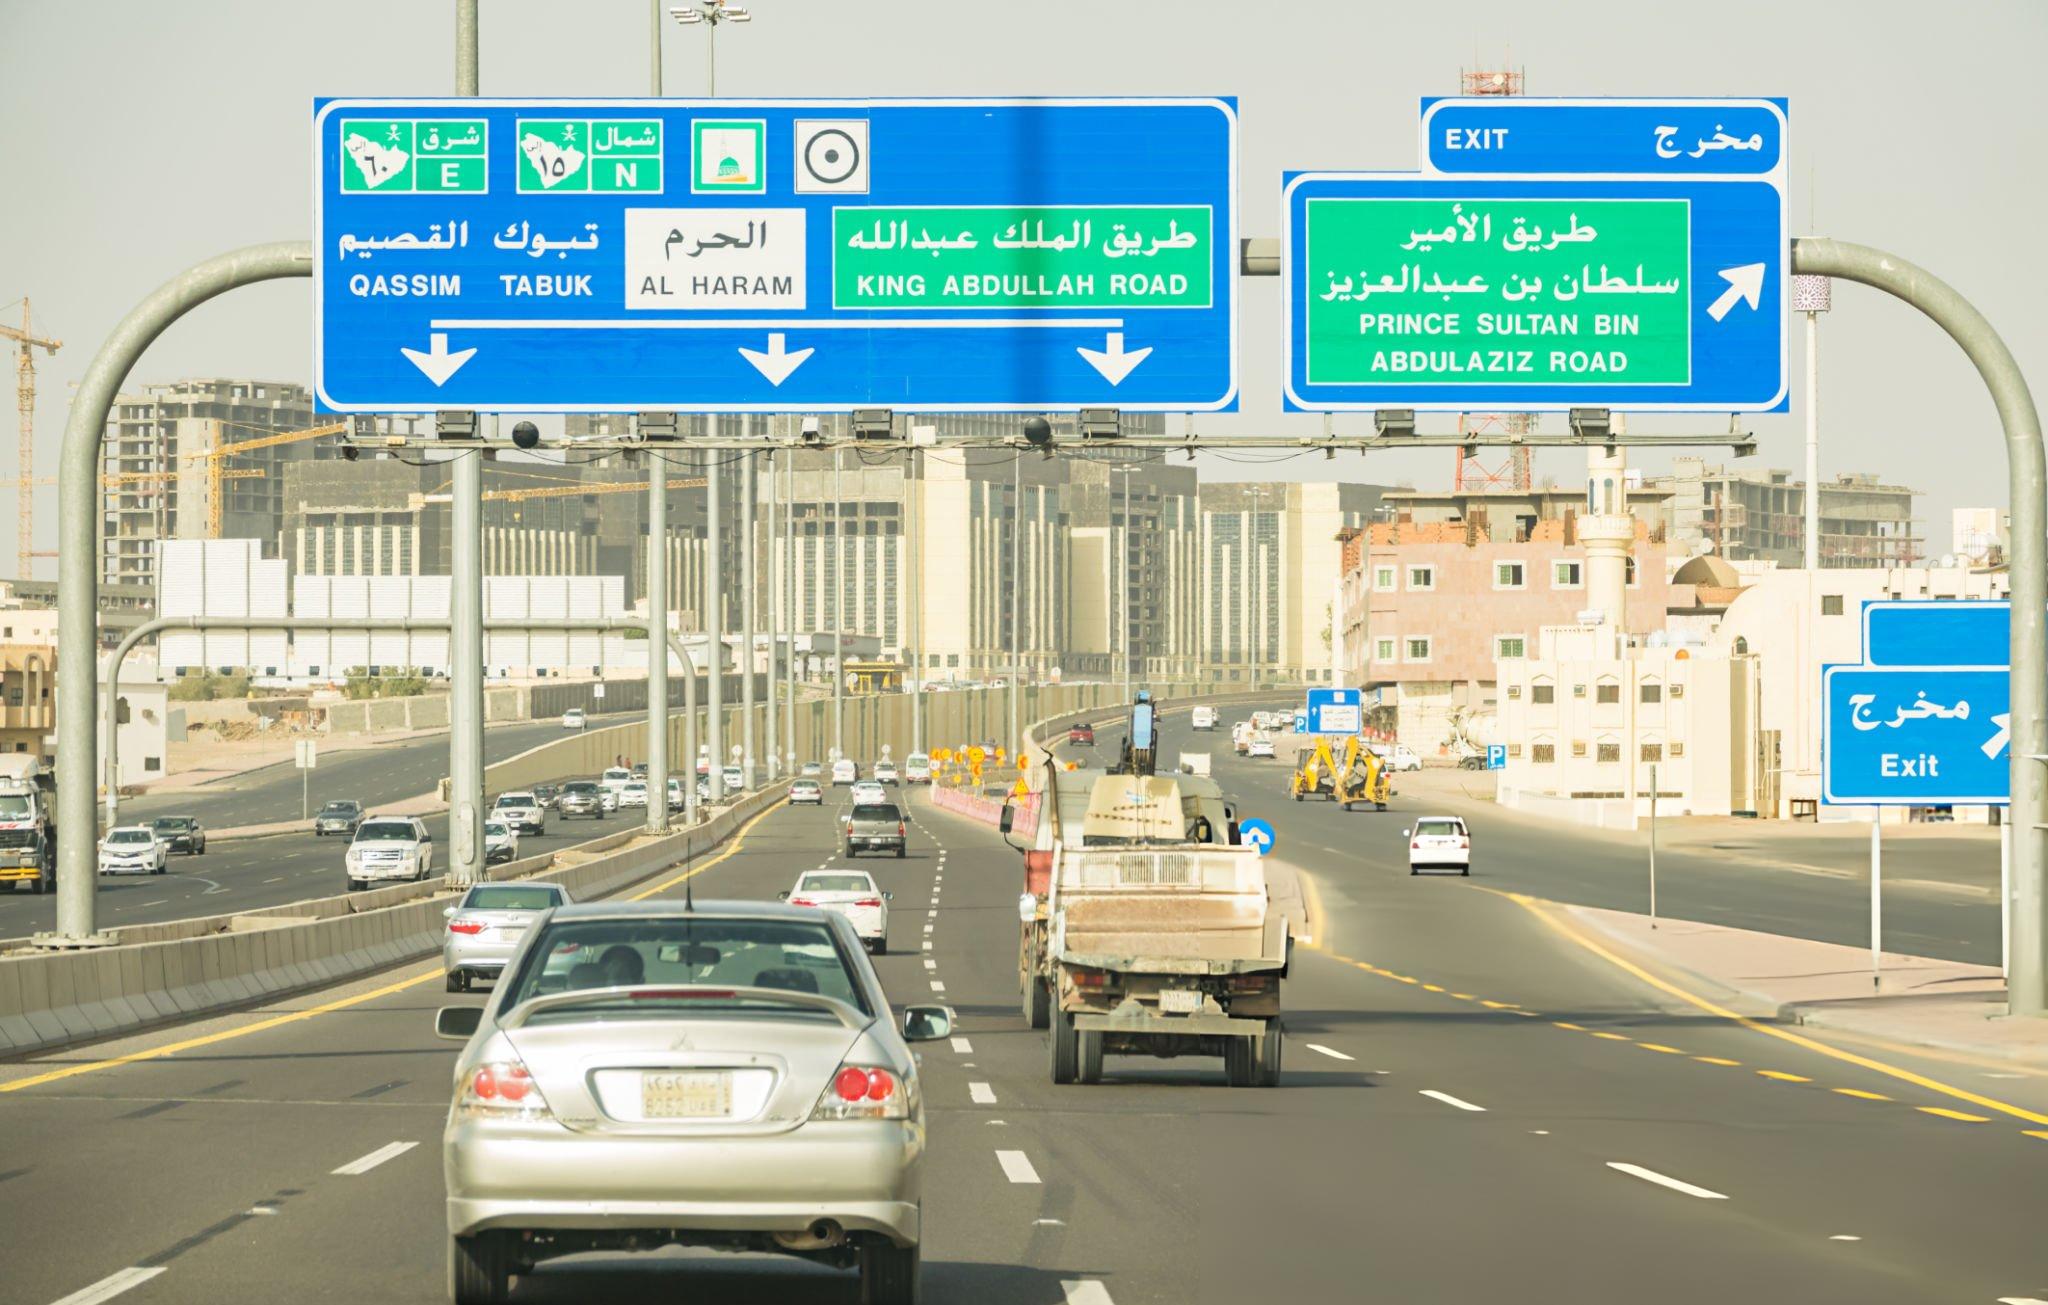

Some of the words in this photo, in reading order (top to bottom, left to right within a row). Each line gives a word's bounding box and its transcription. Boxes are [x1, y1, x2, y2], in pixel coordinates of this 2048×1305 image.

[423, 127, 479, 150] شرق
[596, 128, 655, 151] شمال
[1446, 129, 1508, 149] EXIT
[1655, 125, 1762, 158] مخرج
[442, 163, 459, 187] E
[539, 154, 566, 178] ١٥
[616, 163, 636, 187] N
[848, 220, 977, 257] عبدالله
[994, 220, 1090, 251] الملك
[1103, 220, 1197, 257] طريق
[1401, 204, 1490, 251] الأمير
[1503, 213, 1597, 251] طريق
[339, 221, 467, 260] القصيم
[494, 221, 598, 259] تبوك
[665, 221, 766, 259] الحرم
[350, 275, 460, 297] QASSIM
[500, 275, 592, 296] TABUK
[641, 276, 673, 294] AL
[693, 277, 791, 294] HARAM
[858, 275, 925, 296] KING
[943, 275, 1094, 295] ABDULLAH
[1111, 274, 1187, 295] ROAD
[1321, 264, 1488, 301] عبدالعزيز
[1502, 275, 1542, 301] بن
[1554, 265, 1679, 300] سلطان
[1360, 313, 1459, 334] PRINCE
[1477, 313, 1577, 334] SULTAN
[1595, 315, 1638, 334] BIN
[1371, 351, 1533, 372] ABDULAZIZ
[1550, 351, 1627, 372] ROAD
[1849, 691, 1969, 730] مخرج
[1491, 746, 1504, 765] P
[1882, 754, 1938, 776] Exit
